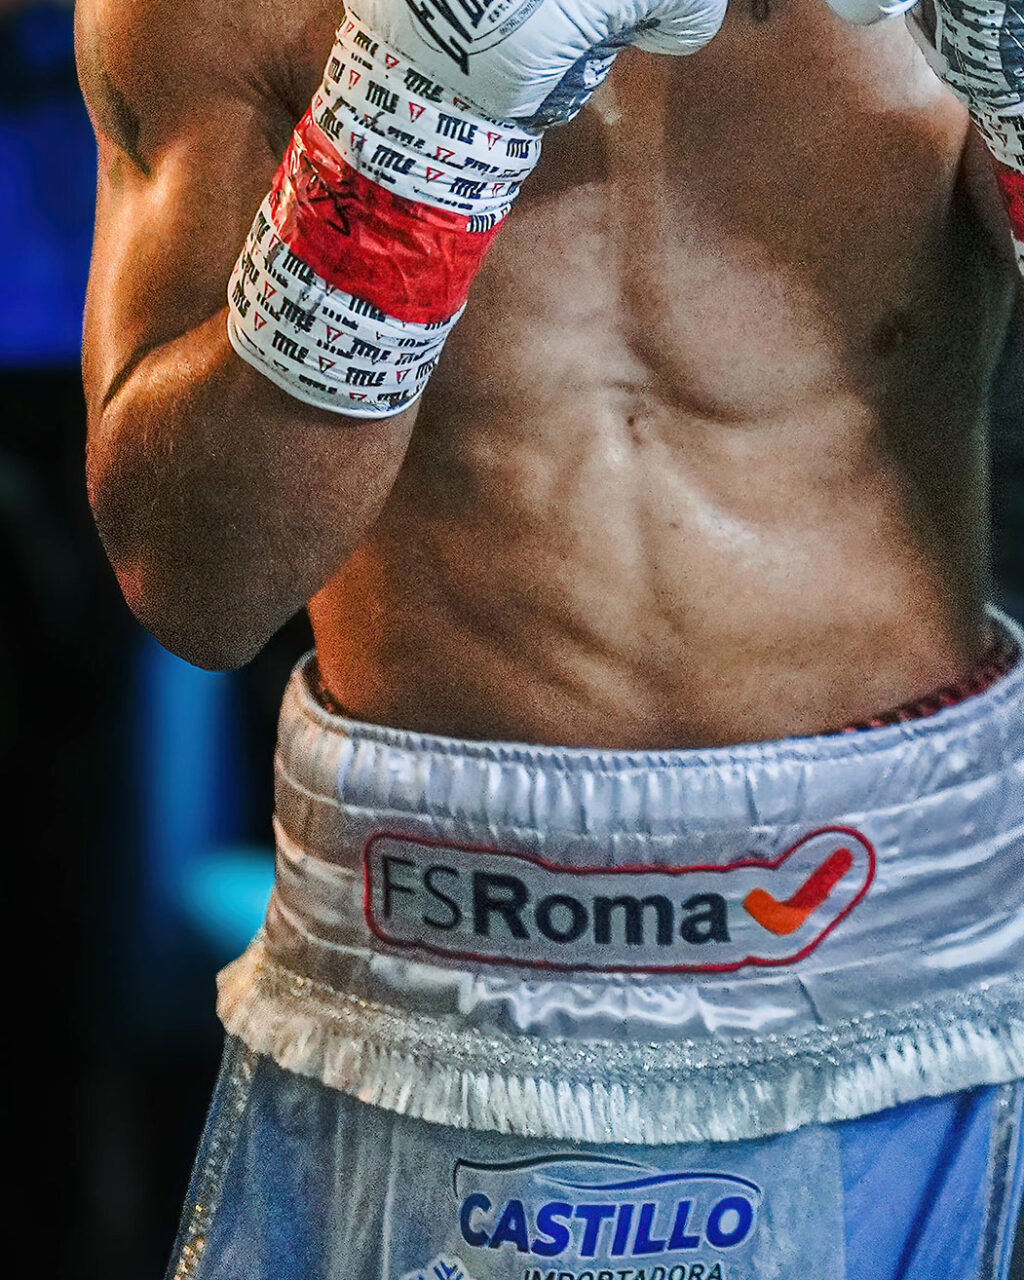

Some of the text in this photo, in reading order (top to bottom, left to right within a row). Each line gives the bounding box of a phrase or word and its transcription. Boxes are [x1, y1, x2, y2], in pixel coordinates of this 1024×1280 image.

[365, 80, 400, 115] TITLE
[435, 113, 479, 145] TITLE
[370, 144, 417, 176] TITLE
[271, 330, 310, 365] TITLE
[345, 366, 389, 388] TITLE
[380, 854, 732, 946] FSRoma
[459, 1192, 754, 1258] CASTILLO
